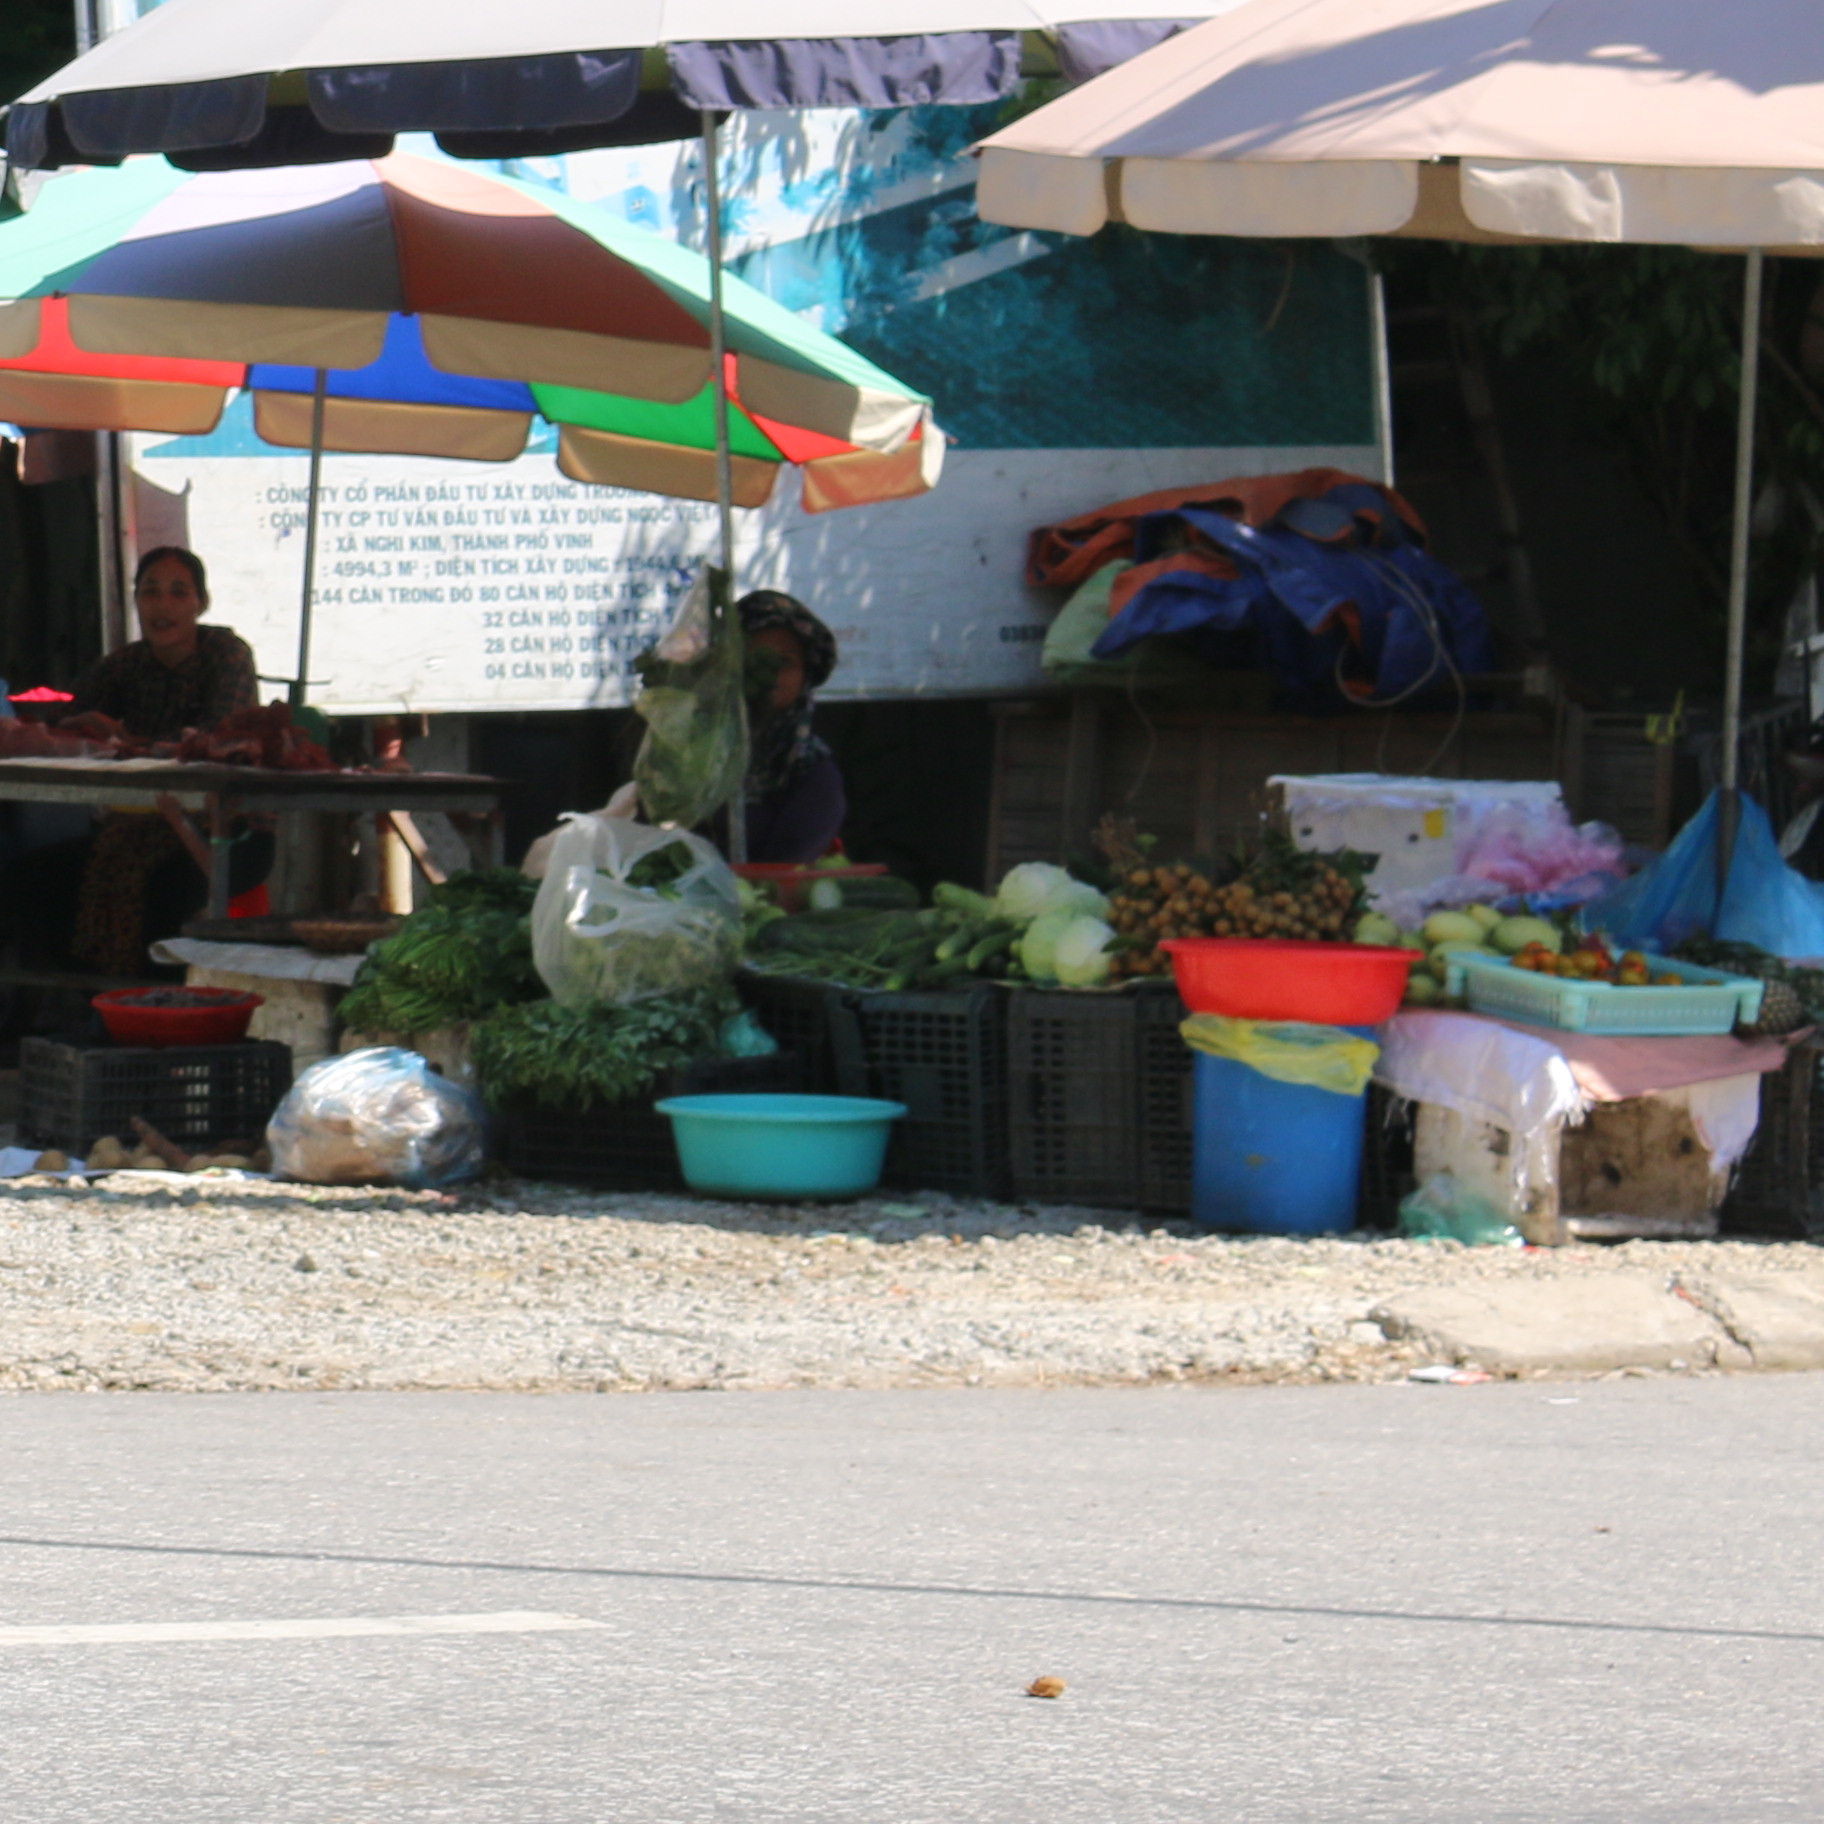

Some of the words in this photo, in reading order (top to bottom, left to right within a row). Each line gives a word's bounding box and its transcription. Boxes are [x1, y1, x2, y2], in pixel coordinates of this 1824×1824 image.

[318, 486, 337, 502] TY
[270, 508, 308, 528] CÔN
[322, 512, 342, 527] TY
[349, 511, 370, 527] CP
[365, 536, 402, 552] NGHI
[410, 536, 446, 554] KIM,
[453, 533, 508, 551] THÀNH
[556, 534, 593, 548] VINH
[334, 562, 392, 579] 4994,3
[483, 558, 518, 574] TÍCH
[388, 587, 444, 603] TRONG
[479, 586, 500, 601] 80
[483, 612, 503, 627] 32
